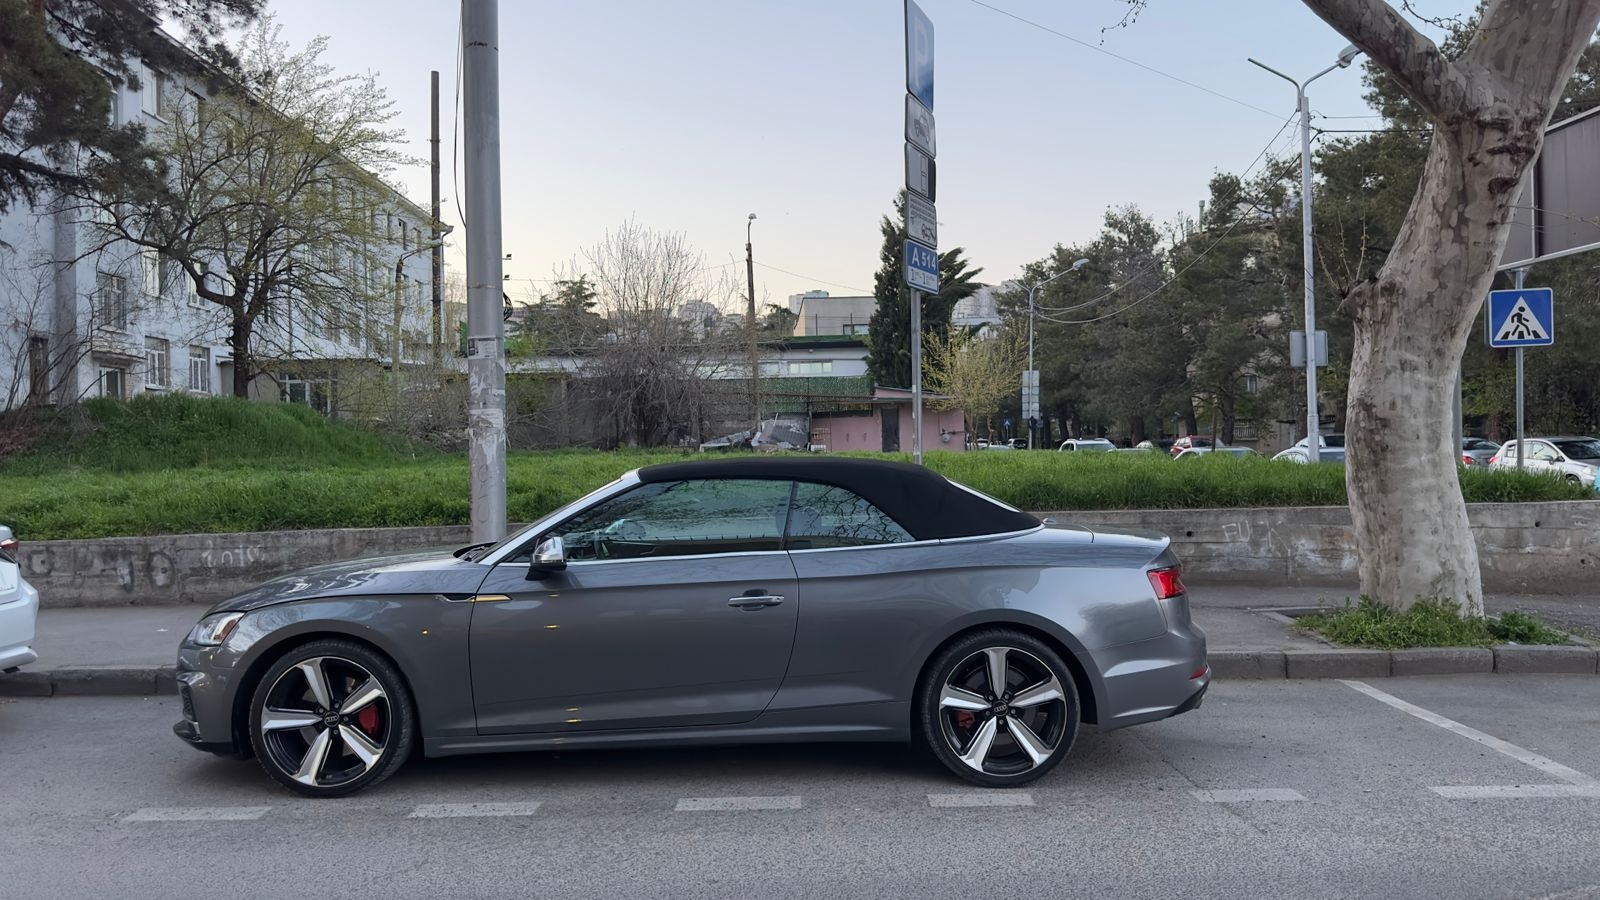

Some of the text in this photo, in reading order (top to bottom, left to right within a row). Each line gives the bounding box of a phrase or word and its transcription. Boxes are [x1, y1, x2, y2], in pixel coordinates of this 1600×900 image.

[914, 16, 929, 90] P
[911, 246, 936, 270] A 514
